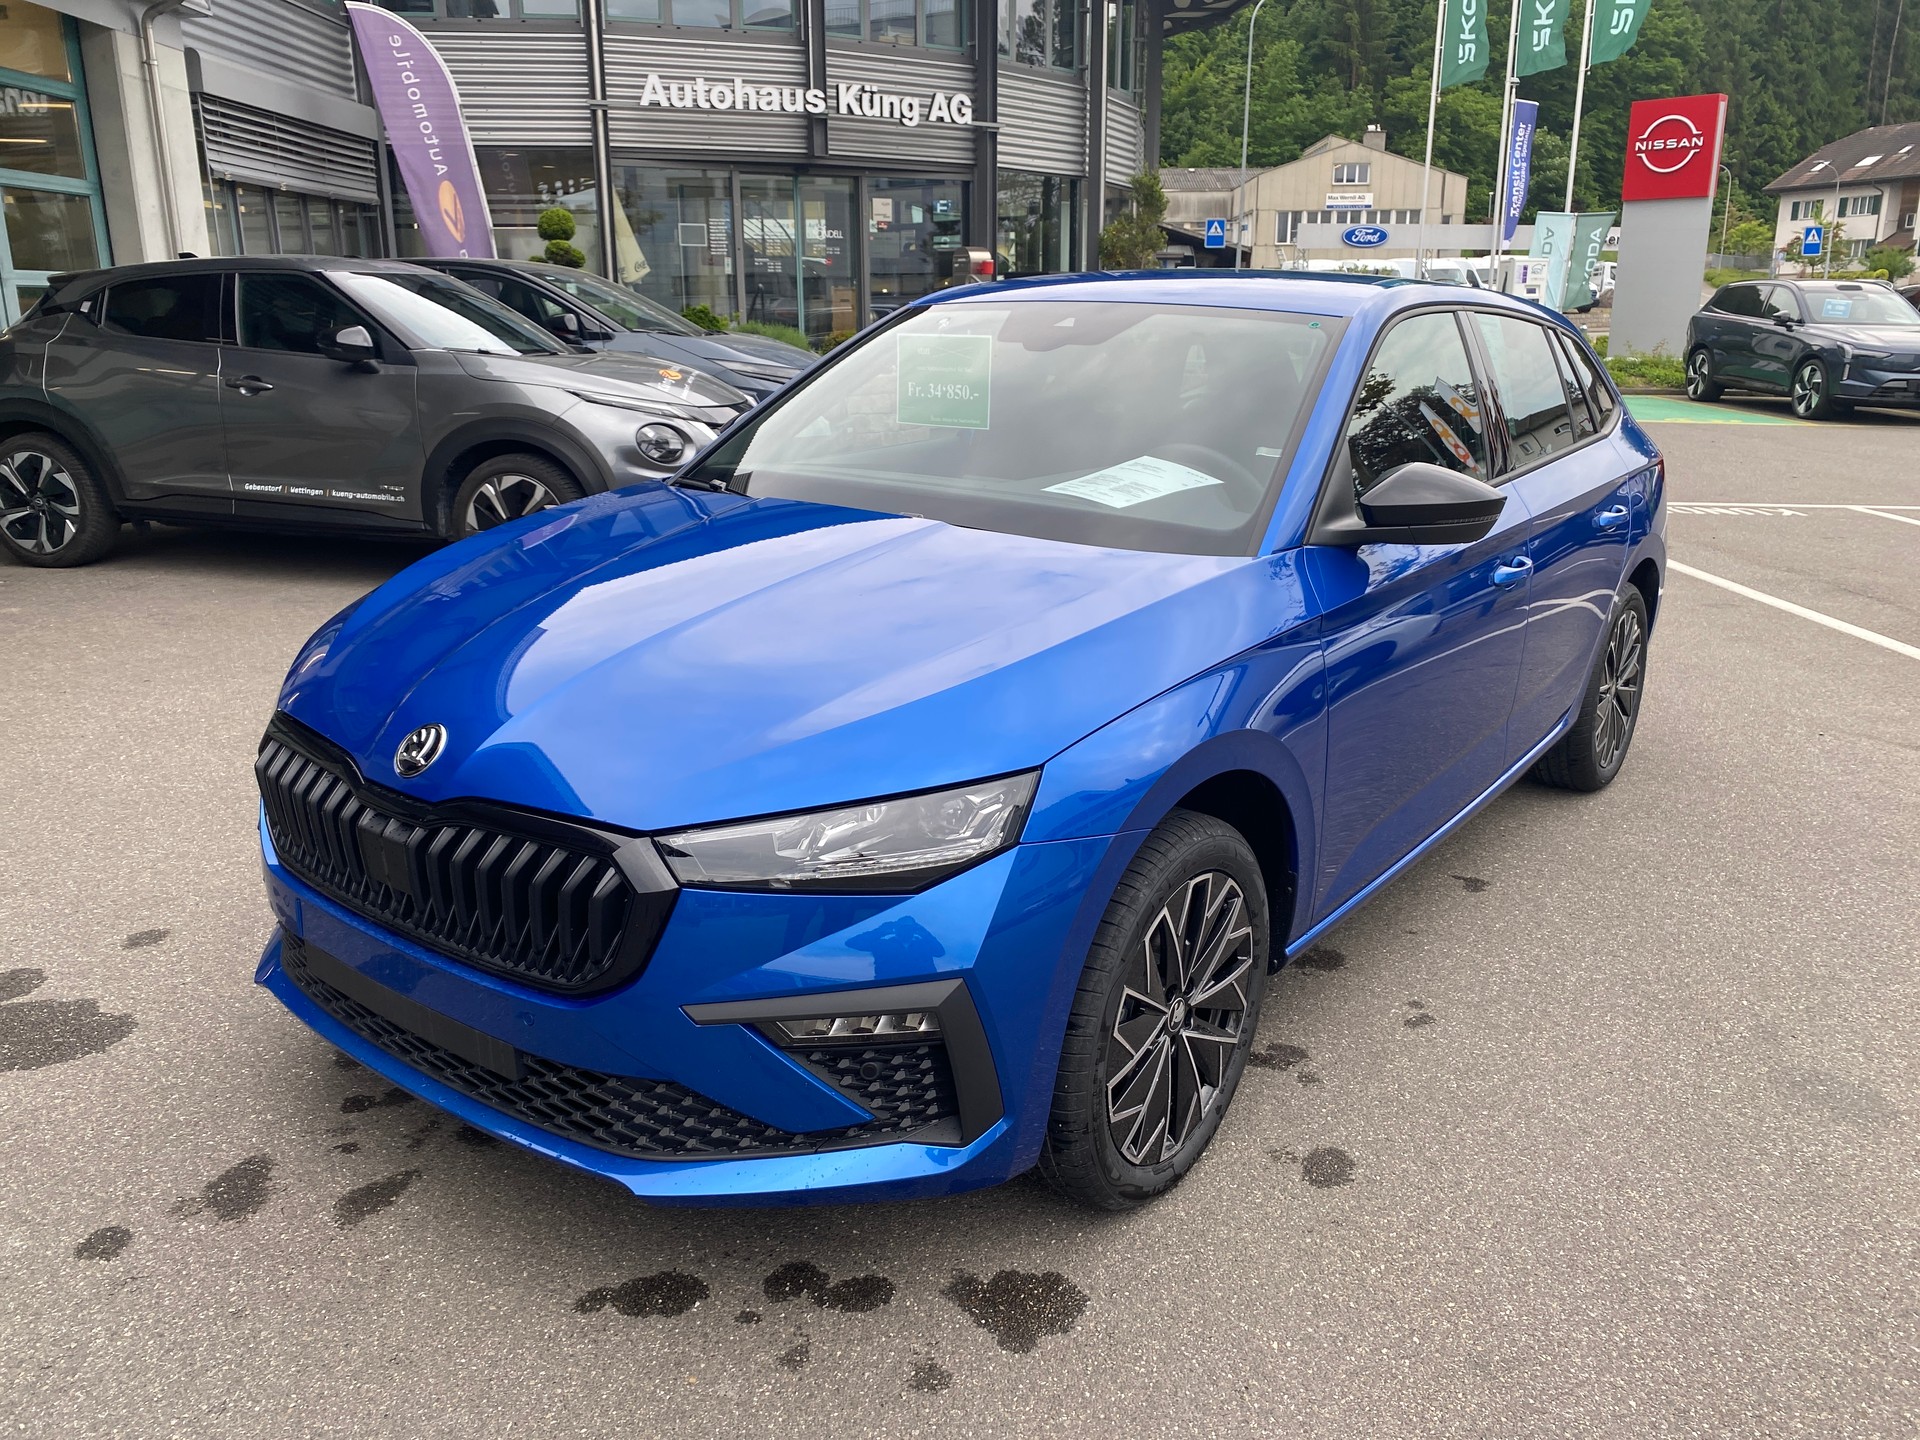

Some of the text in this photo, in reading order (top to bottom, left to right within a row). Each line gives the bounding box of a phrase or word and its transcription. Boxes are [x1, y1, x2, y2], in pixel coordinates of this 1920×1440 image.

[640, 74, 972, 127] Autohaus Küng AG
[1634, 136, 1704, 151] NISSAN
[1510, 121, 1527, 218] Transit Center
[1351, 228, 1380, 243] Ford
[907, 381, 925, 397] Fr.
[244, 482, 405, 502] Gebenstorf Wettingen kueng-automobile.ch
